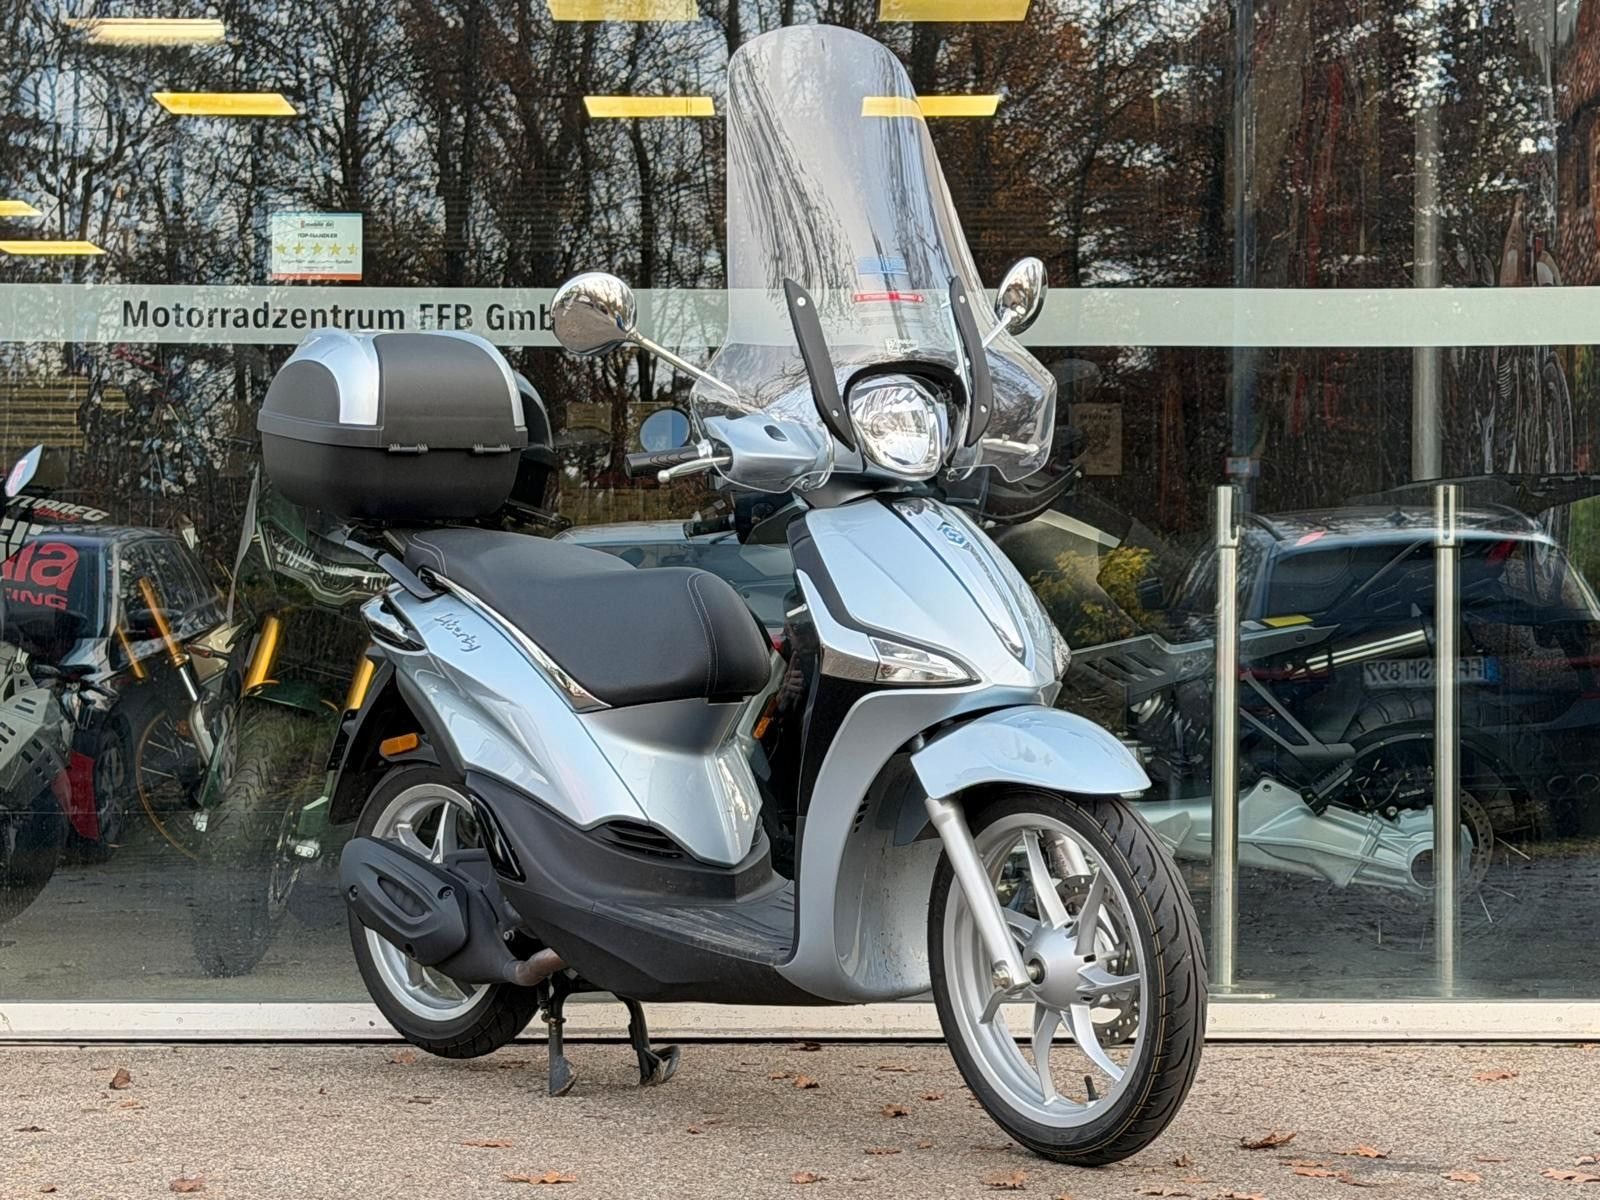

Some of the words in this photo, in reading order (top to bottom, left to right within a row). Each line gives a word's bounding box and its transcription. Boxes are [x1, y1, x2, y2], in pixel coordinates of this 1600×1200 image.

[122, 300, 405, 328] Motorradzentrum
[420, 304, 473, 329] FFB
[486, 305, 556, 330] Gmb
[5, 587, 68, 611] ING
[433, 613, 481, 652] Liberty
